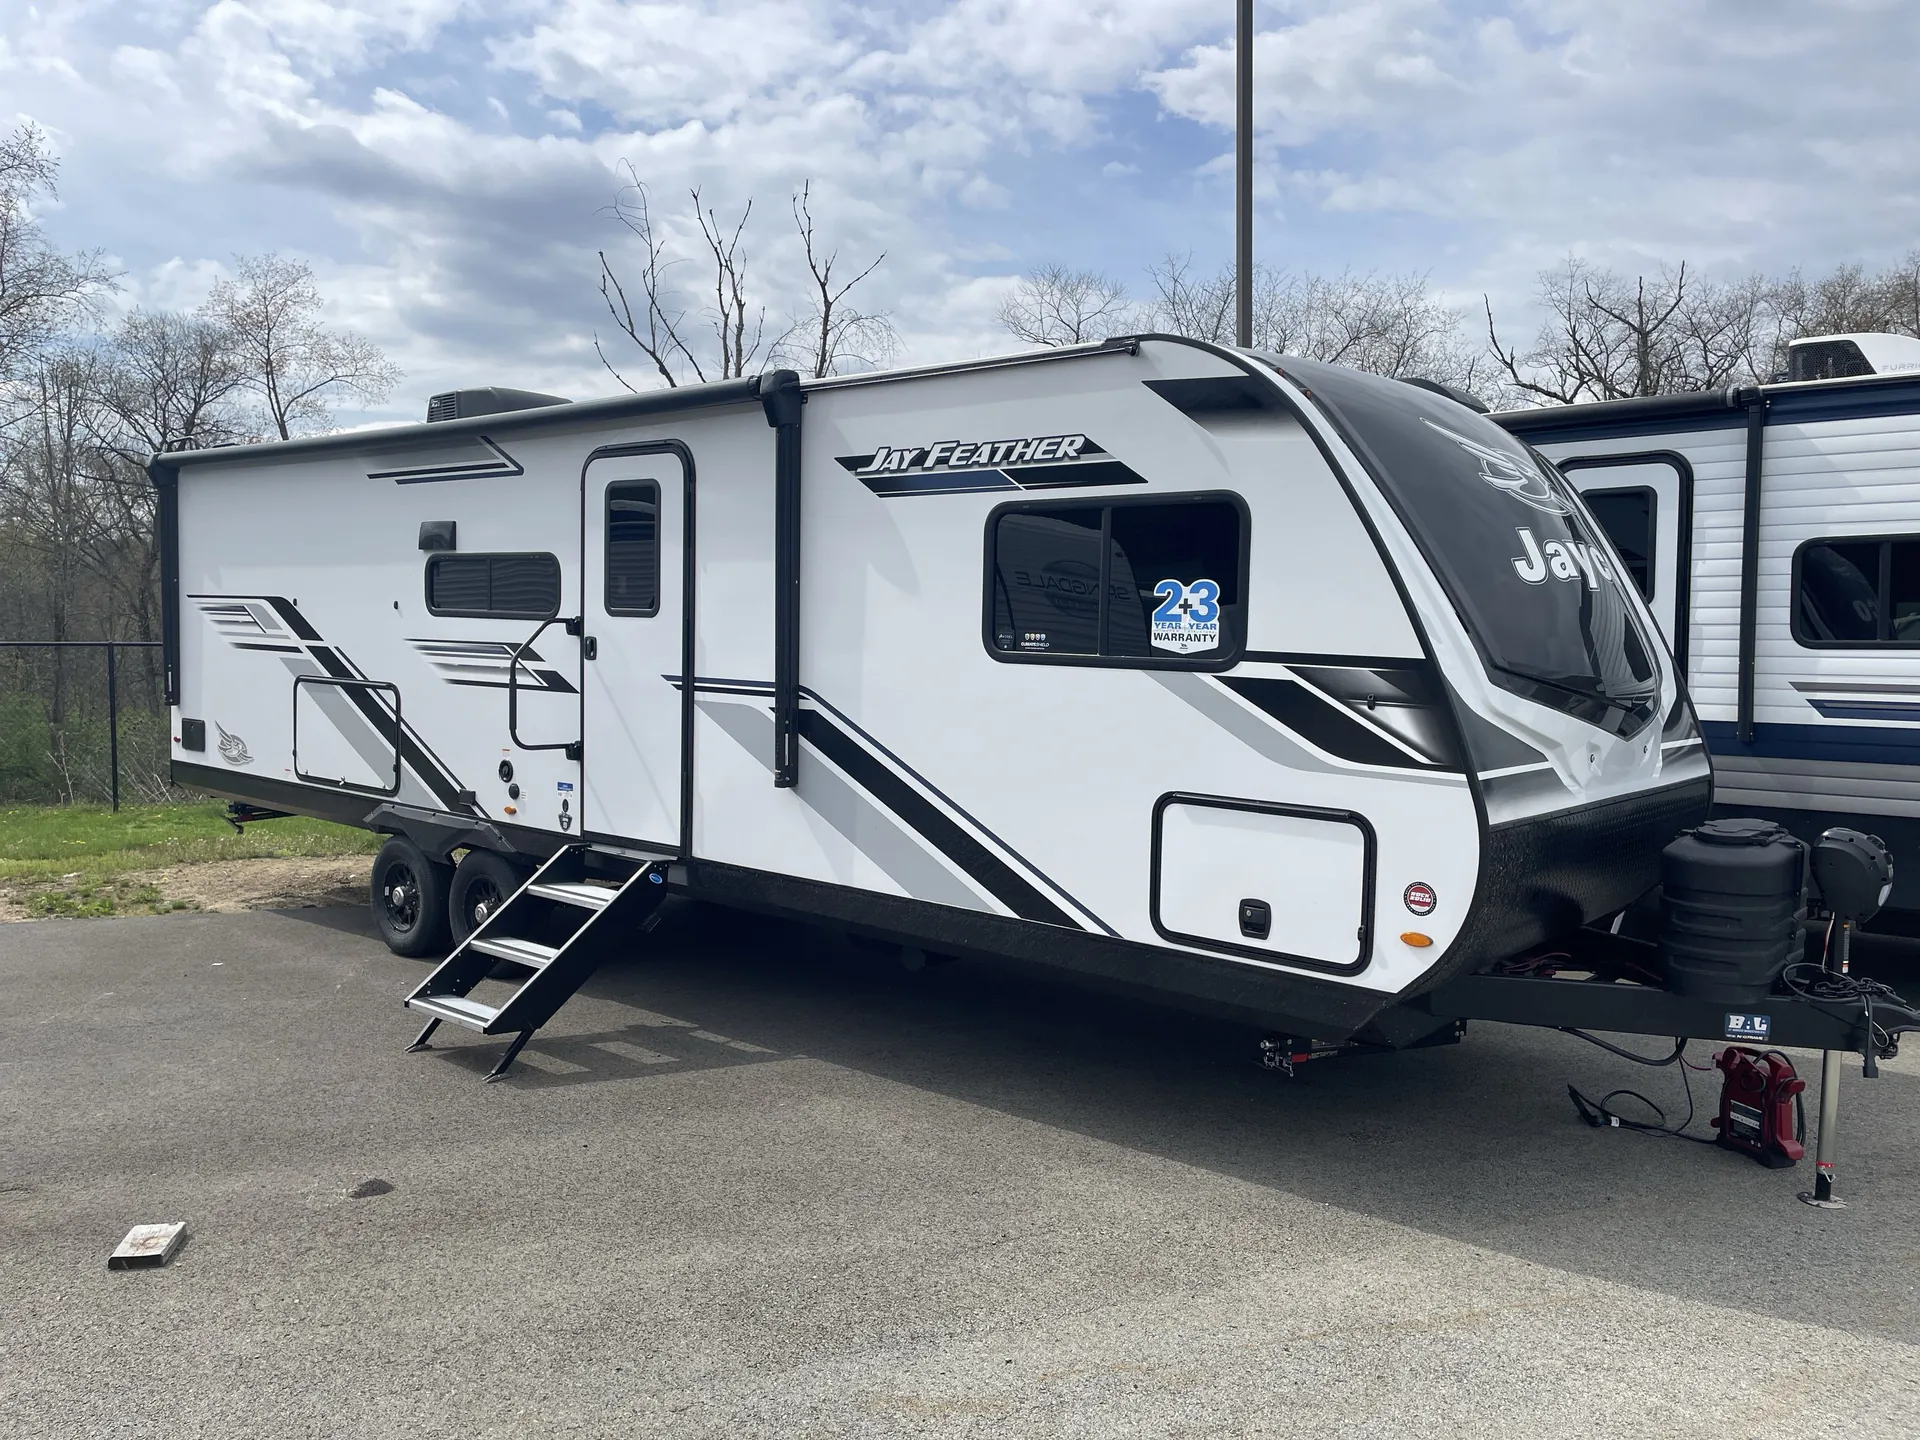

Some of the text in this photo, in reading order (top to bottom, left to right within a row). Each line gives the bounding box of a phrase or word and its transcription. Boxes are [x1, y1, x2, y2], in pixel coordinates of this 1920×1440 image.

[856, 436, 1086, 473] JAY FEATHER
[1154, 622, 1182, 630] YEAR
[1153, 632, 1217, 643] WARRANTY
